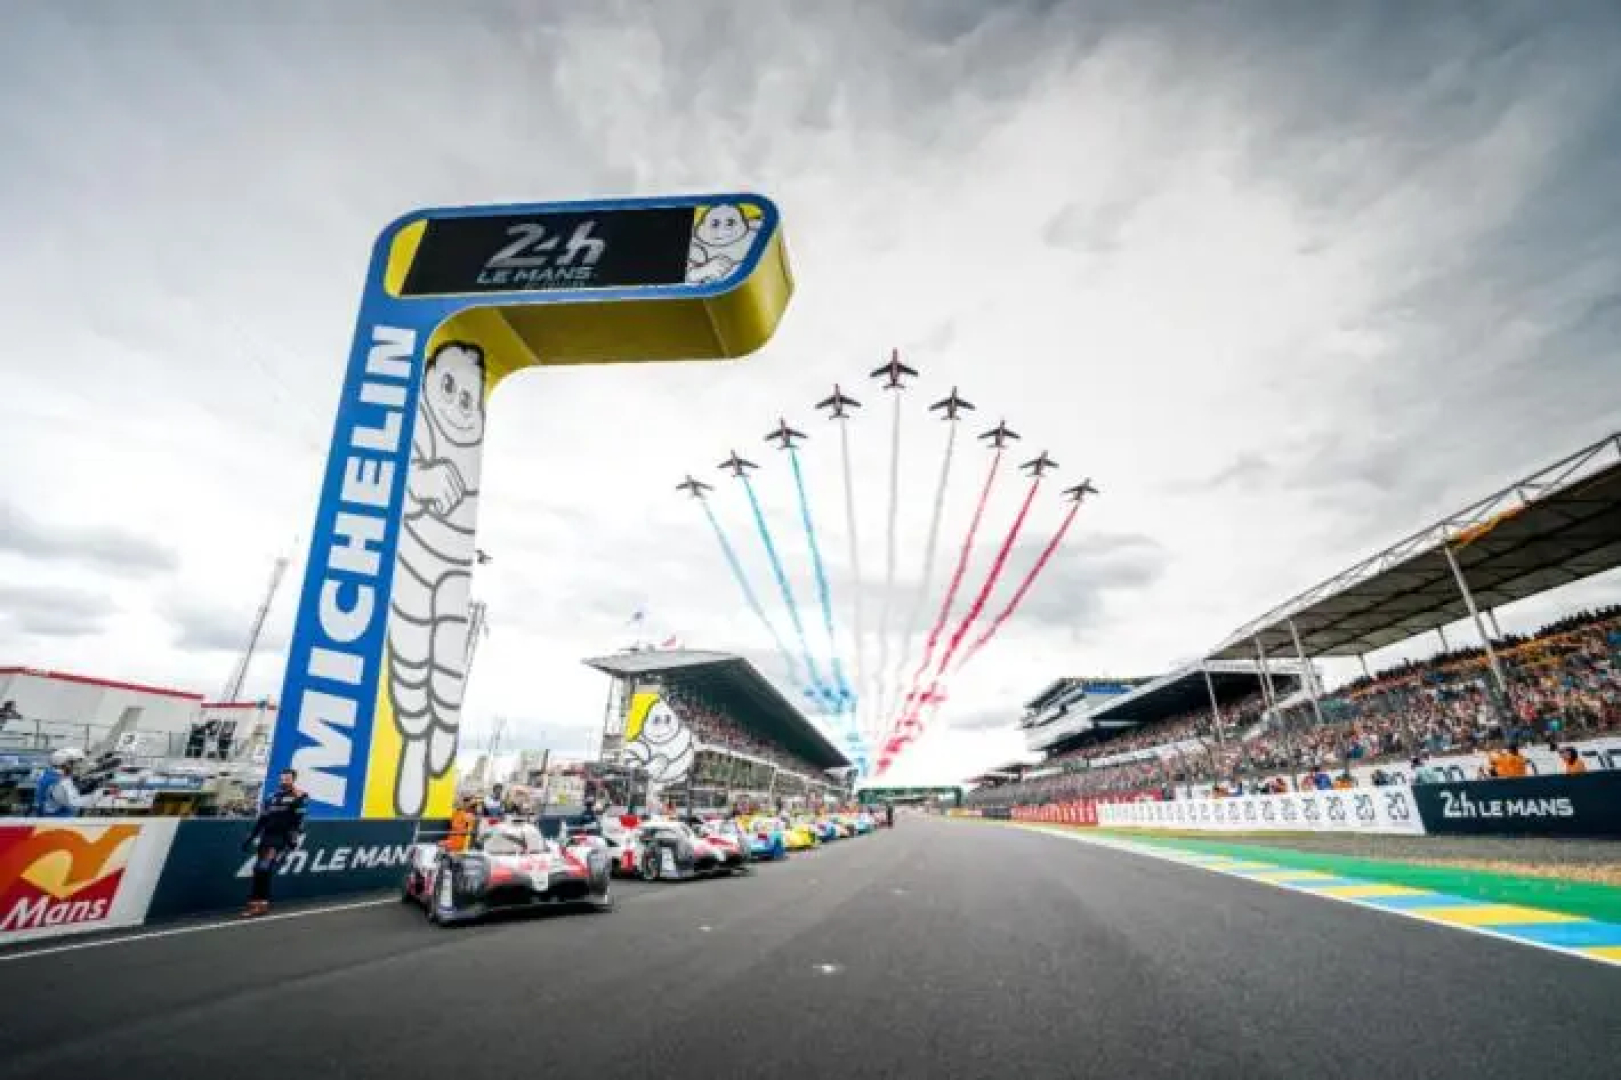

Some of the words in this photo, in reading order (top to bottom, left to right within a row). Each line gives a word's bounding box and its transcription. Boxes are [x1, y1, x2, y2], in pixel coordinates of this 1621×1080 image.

[476, 268, 507, 284] LE
[514, 266, 592, 282] MANS
[291, 325, 416, 806] MICHELIN
[1479, 800, 1503, 817] LE
[1506, 797, 1574, 817] MANS
[310, 847, 353, 872] LE
[352, 844, 412, 869] MAN
[1, 896, 108, 929] Mans
